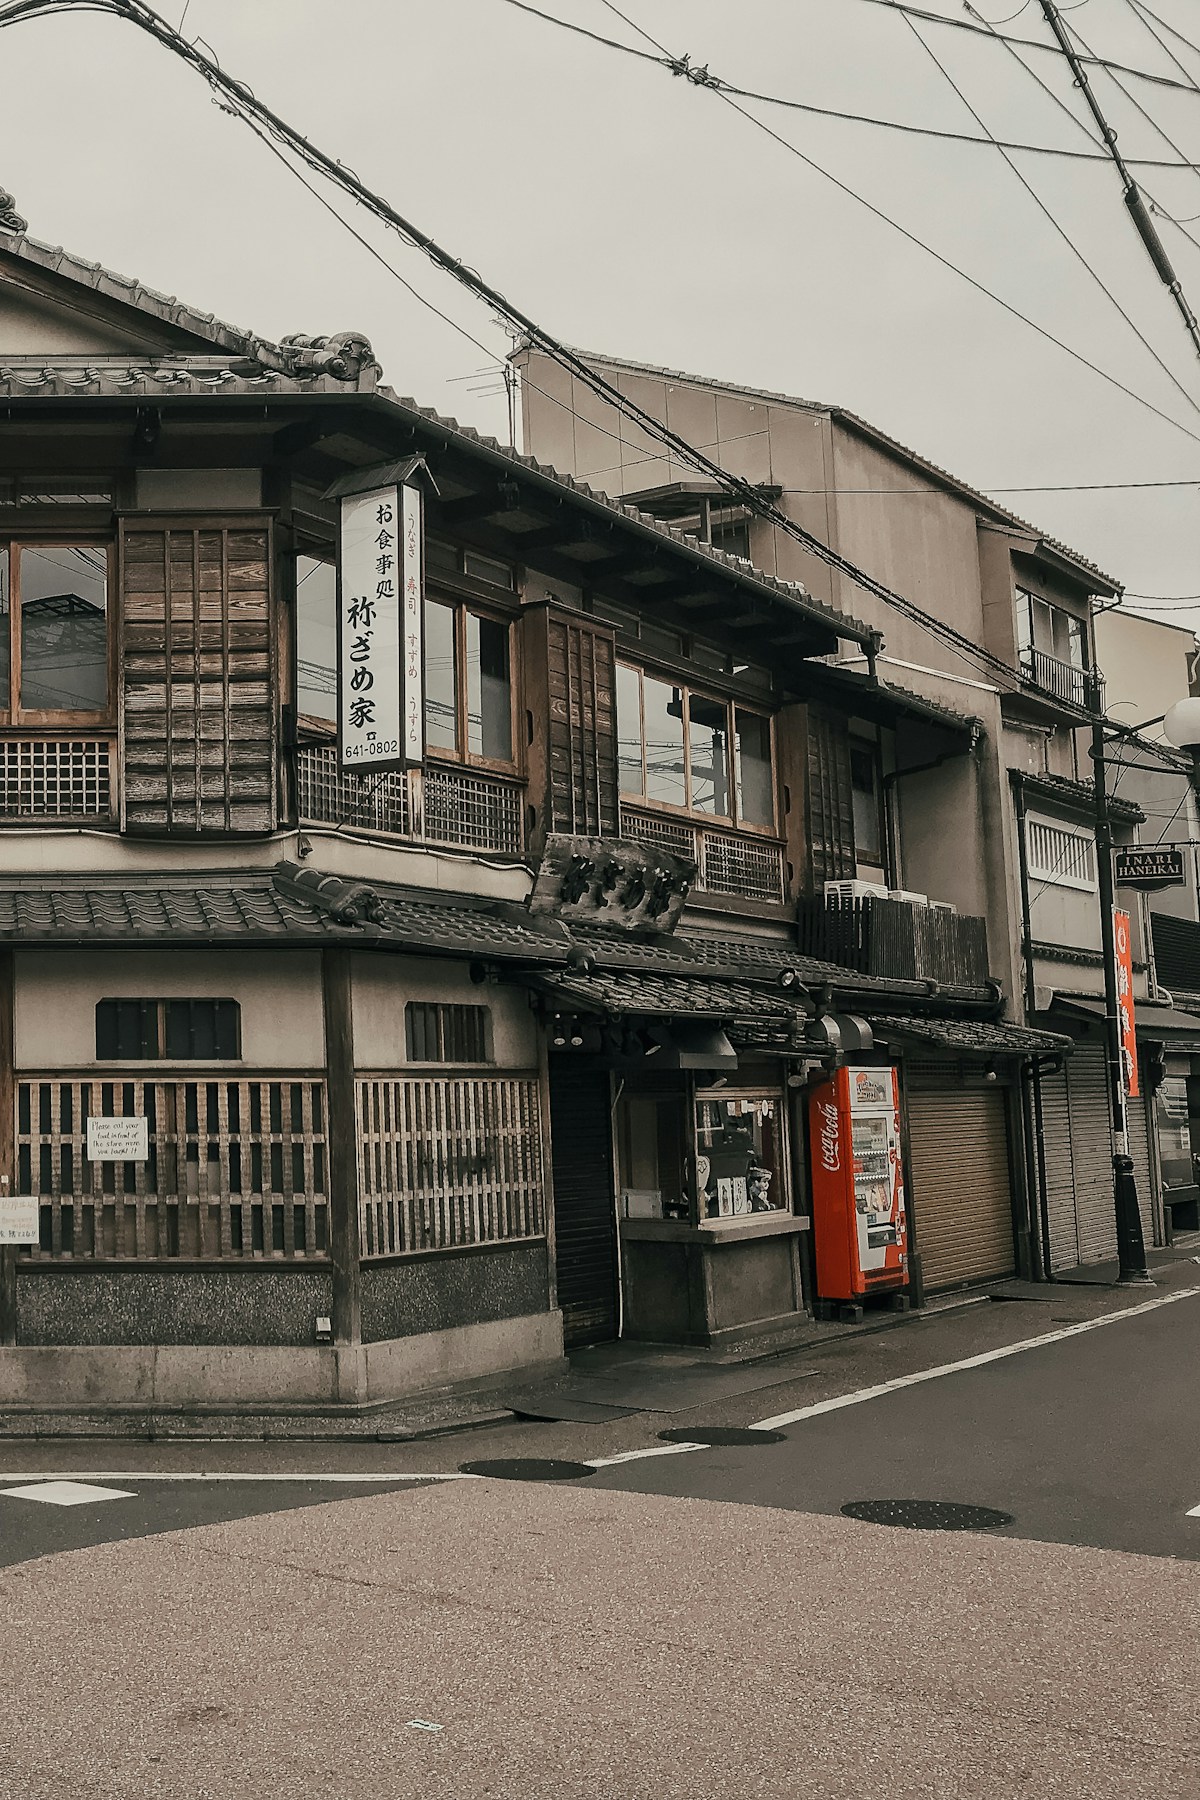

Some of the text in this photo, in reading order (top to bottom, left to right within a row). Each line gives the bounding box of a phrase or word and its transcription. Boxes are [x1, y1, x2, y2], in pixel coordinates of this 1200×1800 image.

[374, 504, 395, 599] お食事処
[406, 576, 418, 615] 寿司
[345, 740, 398, 758] 641-0802
[1125, 854, 1173, 866] INARI
[1119, 864, 1181, 876] HANEIKAI
